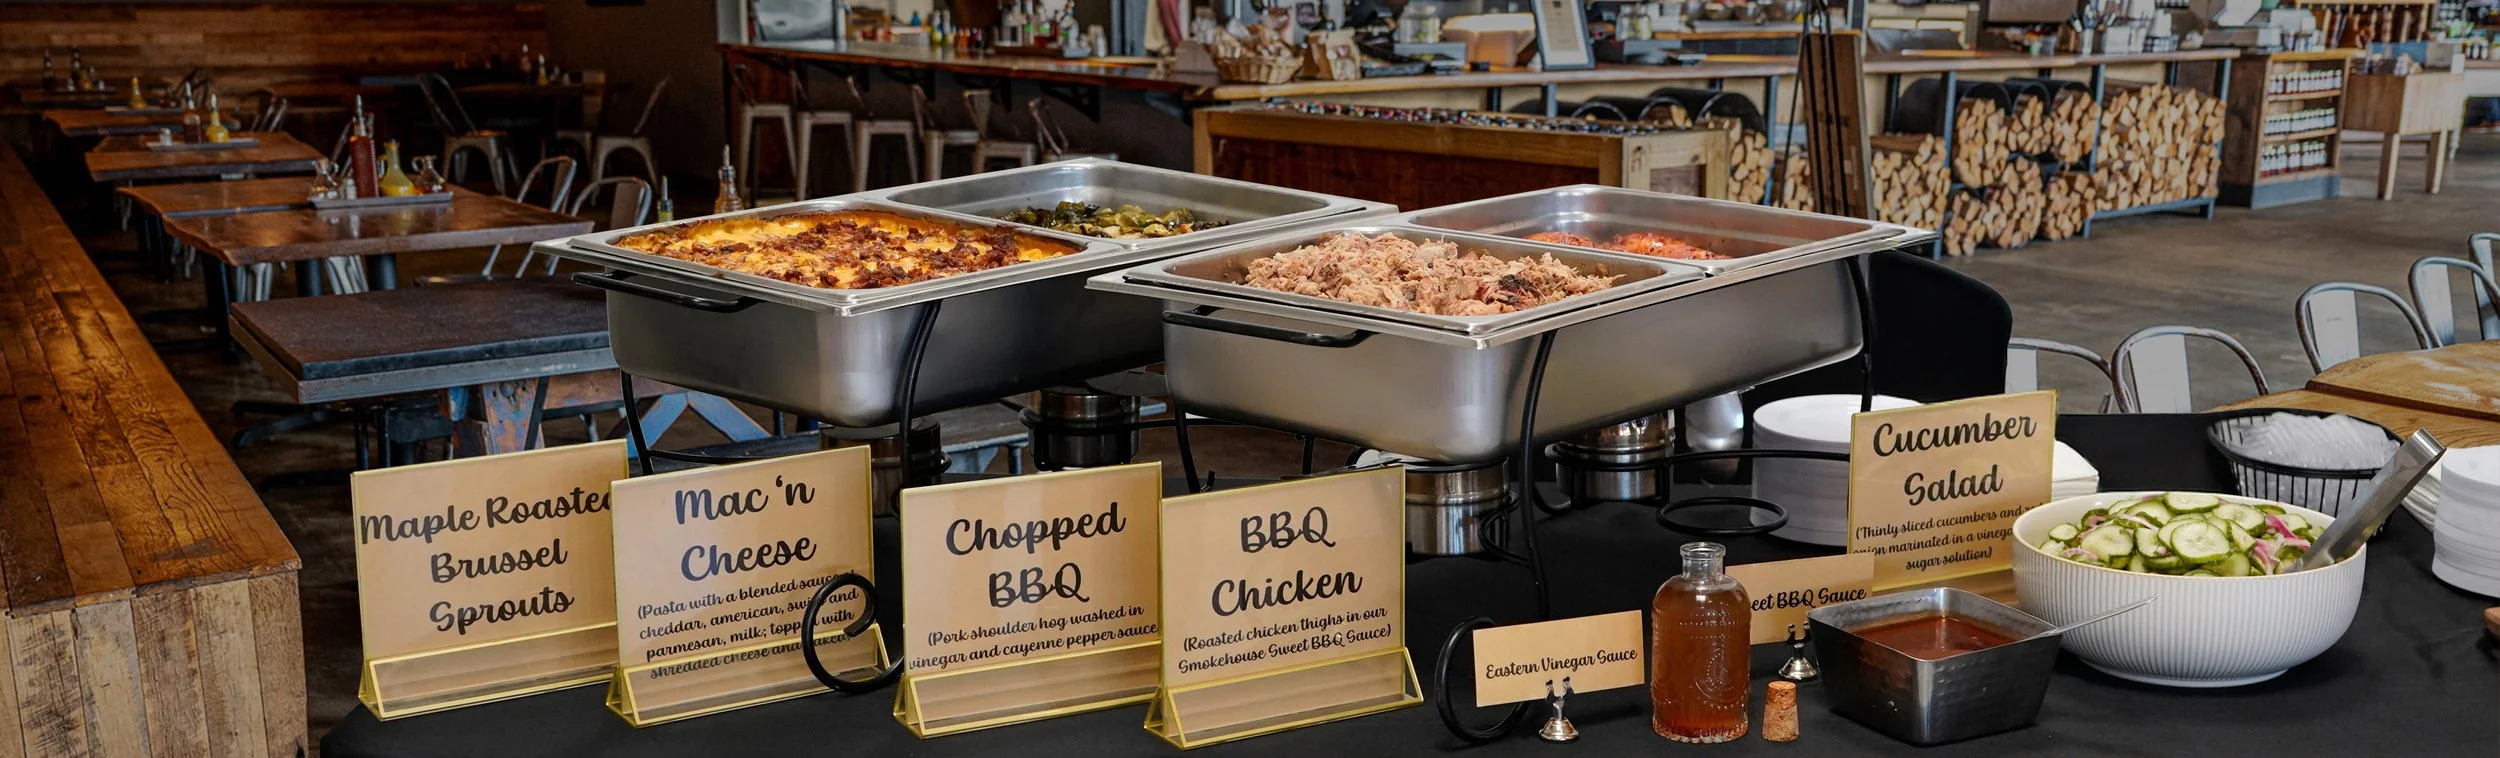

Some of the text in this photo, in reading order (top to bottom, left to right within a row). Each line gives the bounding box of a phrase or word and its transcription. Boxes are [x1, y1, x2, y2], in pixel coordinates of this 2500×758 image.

[1873, 413, 2037, 457] Cucumber
[675, 486, 768, 525] Mac
[1904, 464, 2003, 506] Salad
[360, 504, 480, 545] Maple
[946, 501, 1126, 556] Chopped
[1240, 506, 1336, 553] BBQ
[1856, 524, 1901, 541] (Thinly
[1901, 517, 1935, 533] sliced
[1936, 510, 1997, 527] cucumbers
[1999, 505, 2025, 519] and
[1888, 534, 1951, 553] marinated
[1952, 534, 1966, 544] in
[1966, 533, 1976, 542] a
[1976, 526, 2013, 542] vinega
[430, 538, 568, 583] Brussel
[680, 536, 817, 582] Cheese
[1906, 547, 1993, 572] sugar solution)
[637, 598, 688, 621] (Pasta
[688, 590, 725, 611] with
[725, 592, 738, 604] a
[739, 580, 798, 601] blended
[988, 562, 1090, 608] BBQ
[1211, 569, 1363, 617] Chicken
[1751, 587, 1867, 611] eet BBQ Sauce
[430, 586, 575, 635] Sprouts
[639, 618, 707, 640] cheddar,
[710, 605, 785, 627] american,
[829, 588, 859, 603] and
[928, 605, 1145, 648] (Pork shoulder hog washed in
[1183, 608, 1387, 653] (Roasted chicken thighs in our
[646, 609, 854, 662] parmesan, milk; topp with
[723, 647, 771, 665] cheese
[909, 653, 968, 670] vinegar
[969, 644, 1002, 660] and
[1002, 638, 1065, 658] cayenne
[1066, 631, 1117, 651] pepper
[1178, 623, 1392, 674] Smokehouse Sweet BBQ Sauce)
[1486, 648, 1639, 680] Eastern Vinegar Sauce
